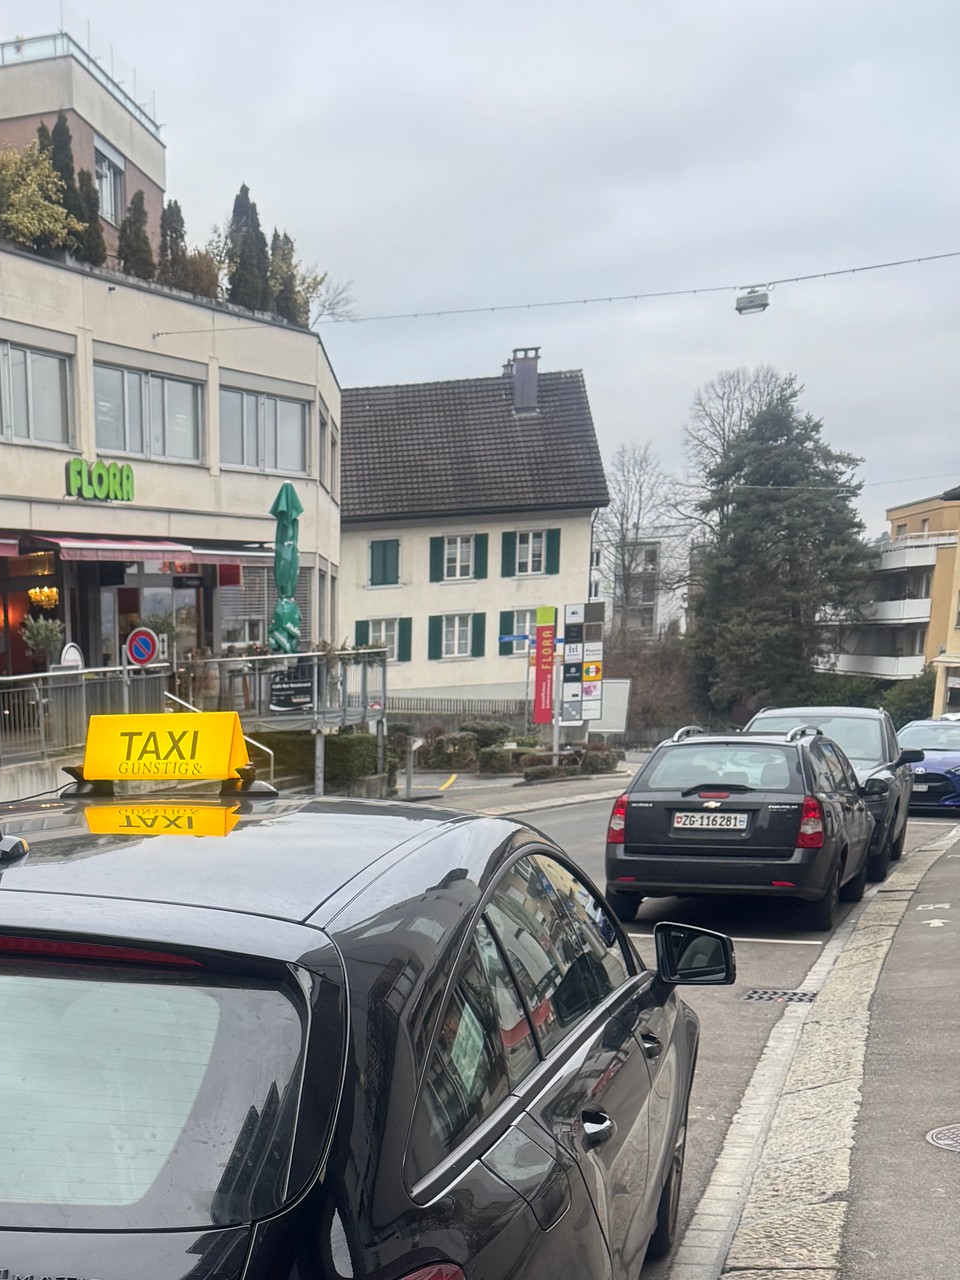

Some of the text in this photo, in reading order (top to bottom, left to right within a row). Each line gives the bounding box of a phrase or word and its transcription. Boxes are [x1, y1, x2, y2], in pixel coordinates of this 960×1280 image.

[67, 457, 134, 501] FLORA
[541, 630, 553, 670] FLORA
[120, 730, 199, 761] TAXI
